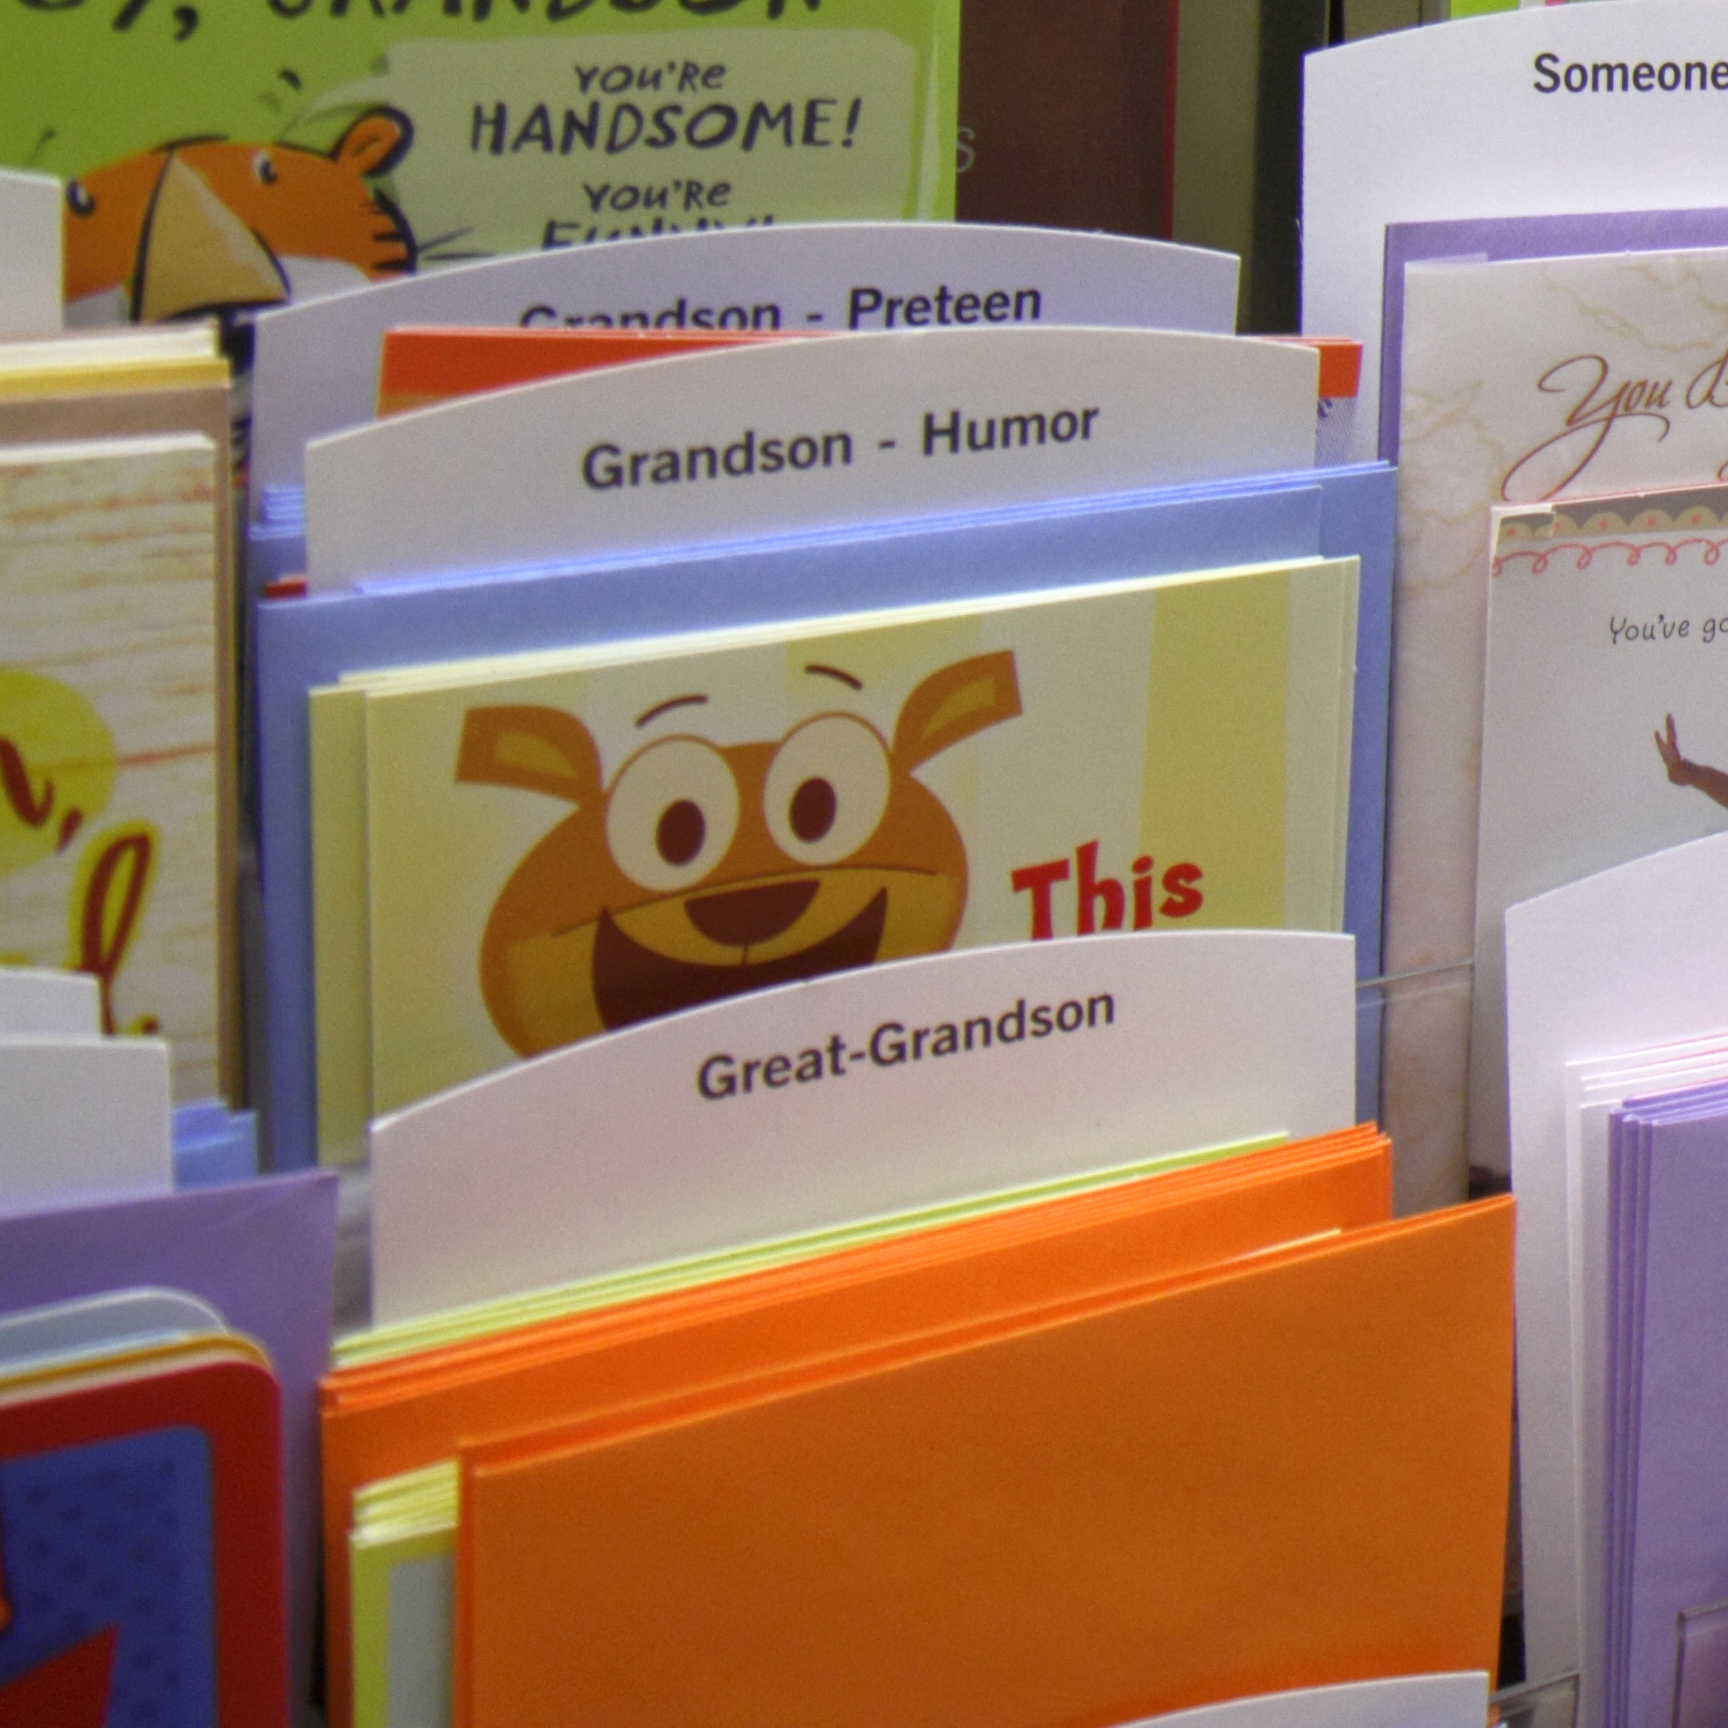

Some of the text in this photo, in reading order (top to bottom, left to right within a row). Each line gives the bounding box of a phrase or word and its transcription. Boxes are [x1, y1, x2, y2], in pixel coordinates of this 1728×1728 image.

[471, 96, 863, 157] HANDSOME!
[849, 279, 1042, 331] Preteen
[581, 399, 1098, 492] Grandson Humor
[1609, 611, 1691, 645] You've
[697, 987, 1117, 1103] Great-Grandson
